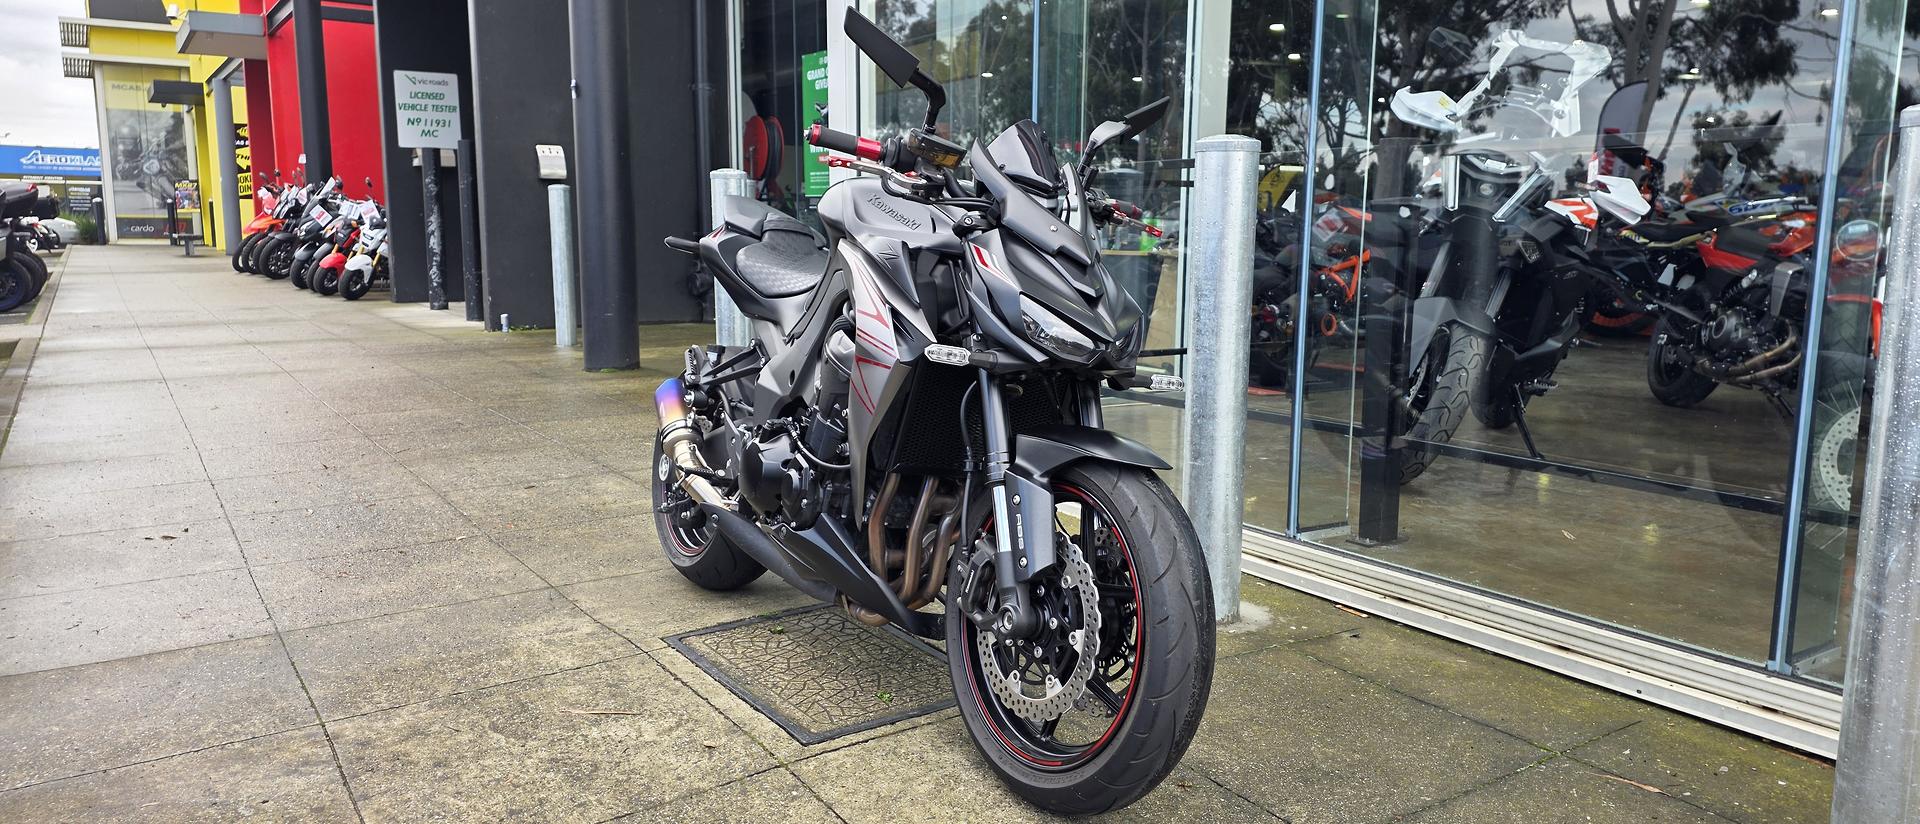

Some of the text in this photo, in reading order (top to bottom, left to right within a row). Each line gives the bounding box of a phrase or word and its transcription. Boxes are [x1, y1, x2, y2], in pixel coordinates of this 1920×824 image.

[410, 91, 445, 100] LICENSED
[398, 103, 457, 113] VEHICLE TESTER
[424, 118, 451, 128] 11931
[420, 129, 439, 137] MC
[867, 194, 922, 231] Kawasaki
[131, 224, 154, 232] cardo
[1016, 513, 1025, 550] ABS
